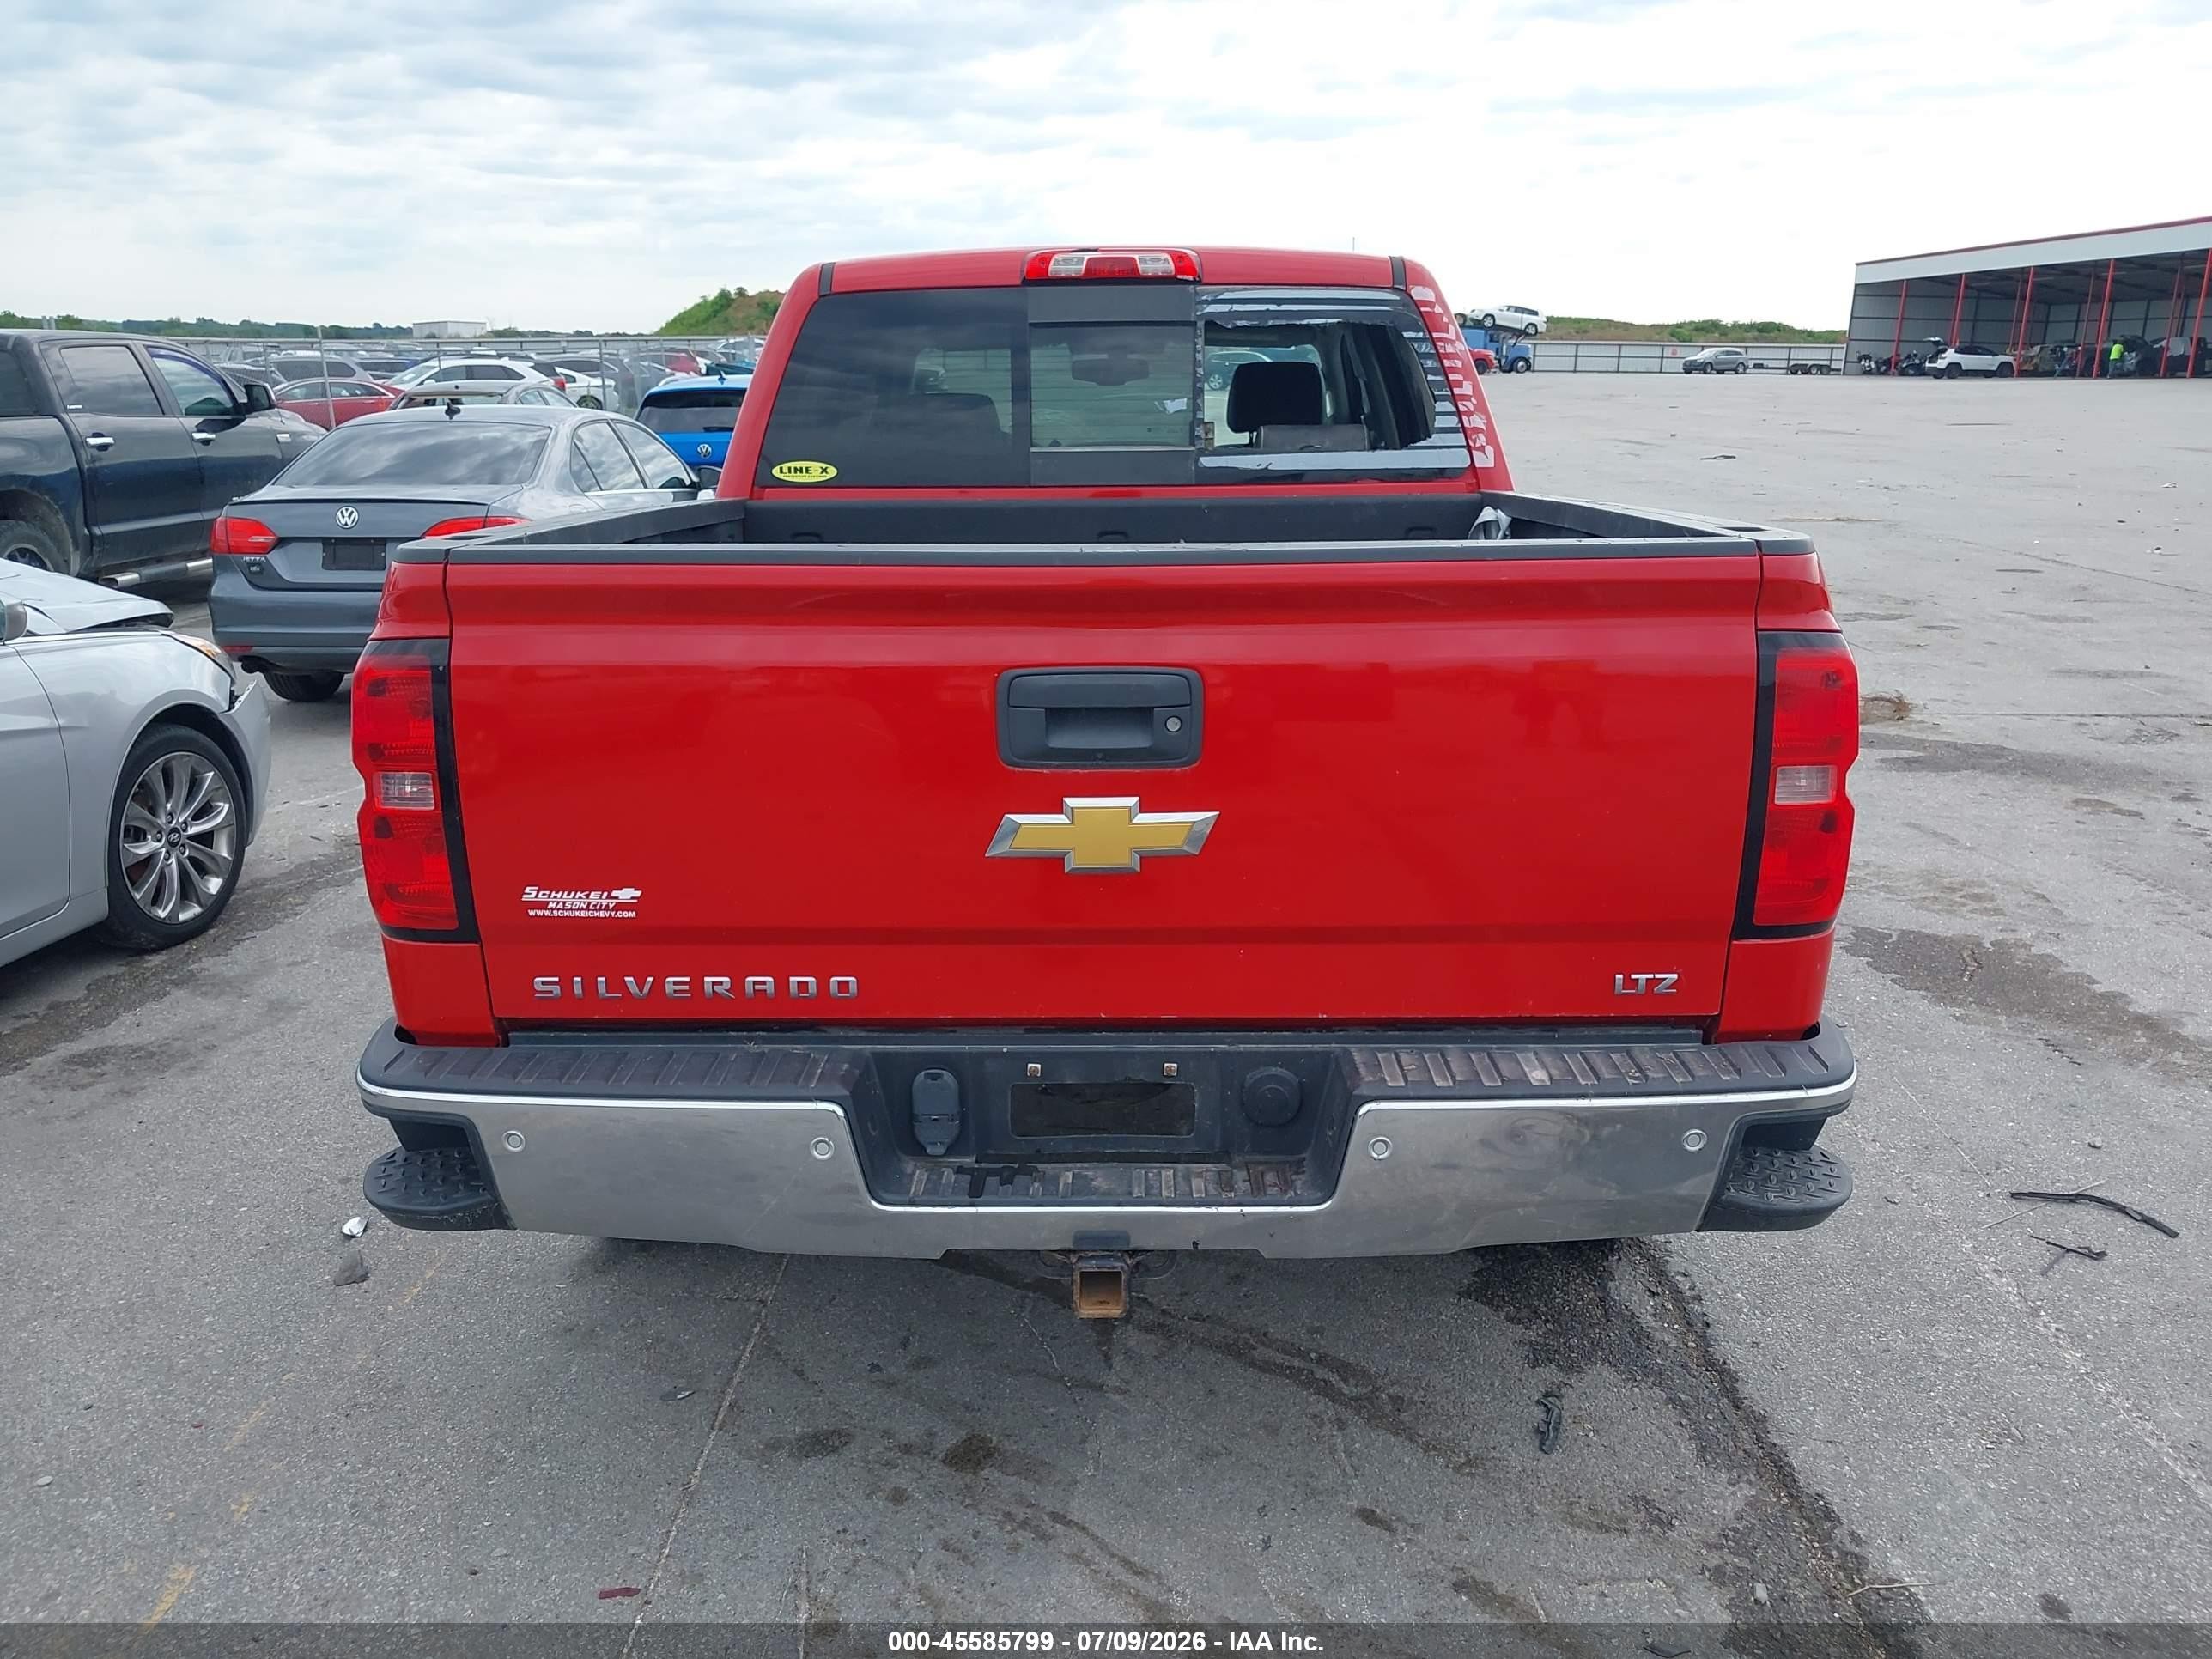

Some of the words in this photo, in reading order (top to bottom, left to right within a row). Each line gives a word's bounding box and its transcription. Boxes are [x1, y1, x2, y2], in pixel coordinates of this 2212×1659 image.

[527, 909, 636, 918] WWW.SCHUKEICHEVY.COM
[589, 902, 617, 910] CITY
[533, 976, 858, 999] SILVERADO
[1614, 973, 1678, 995] LTZ
